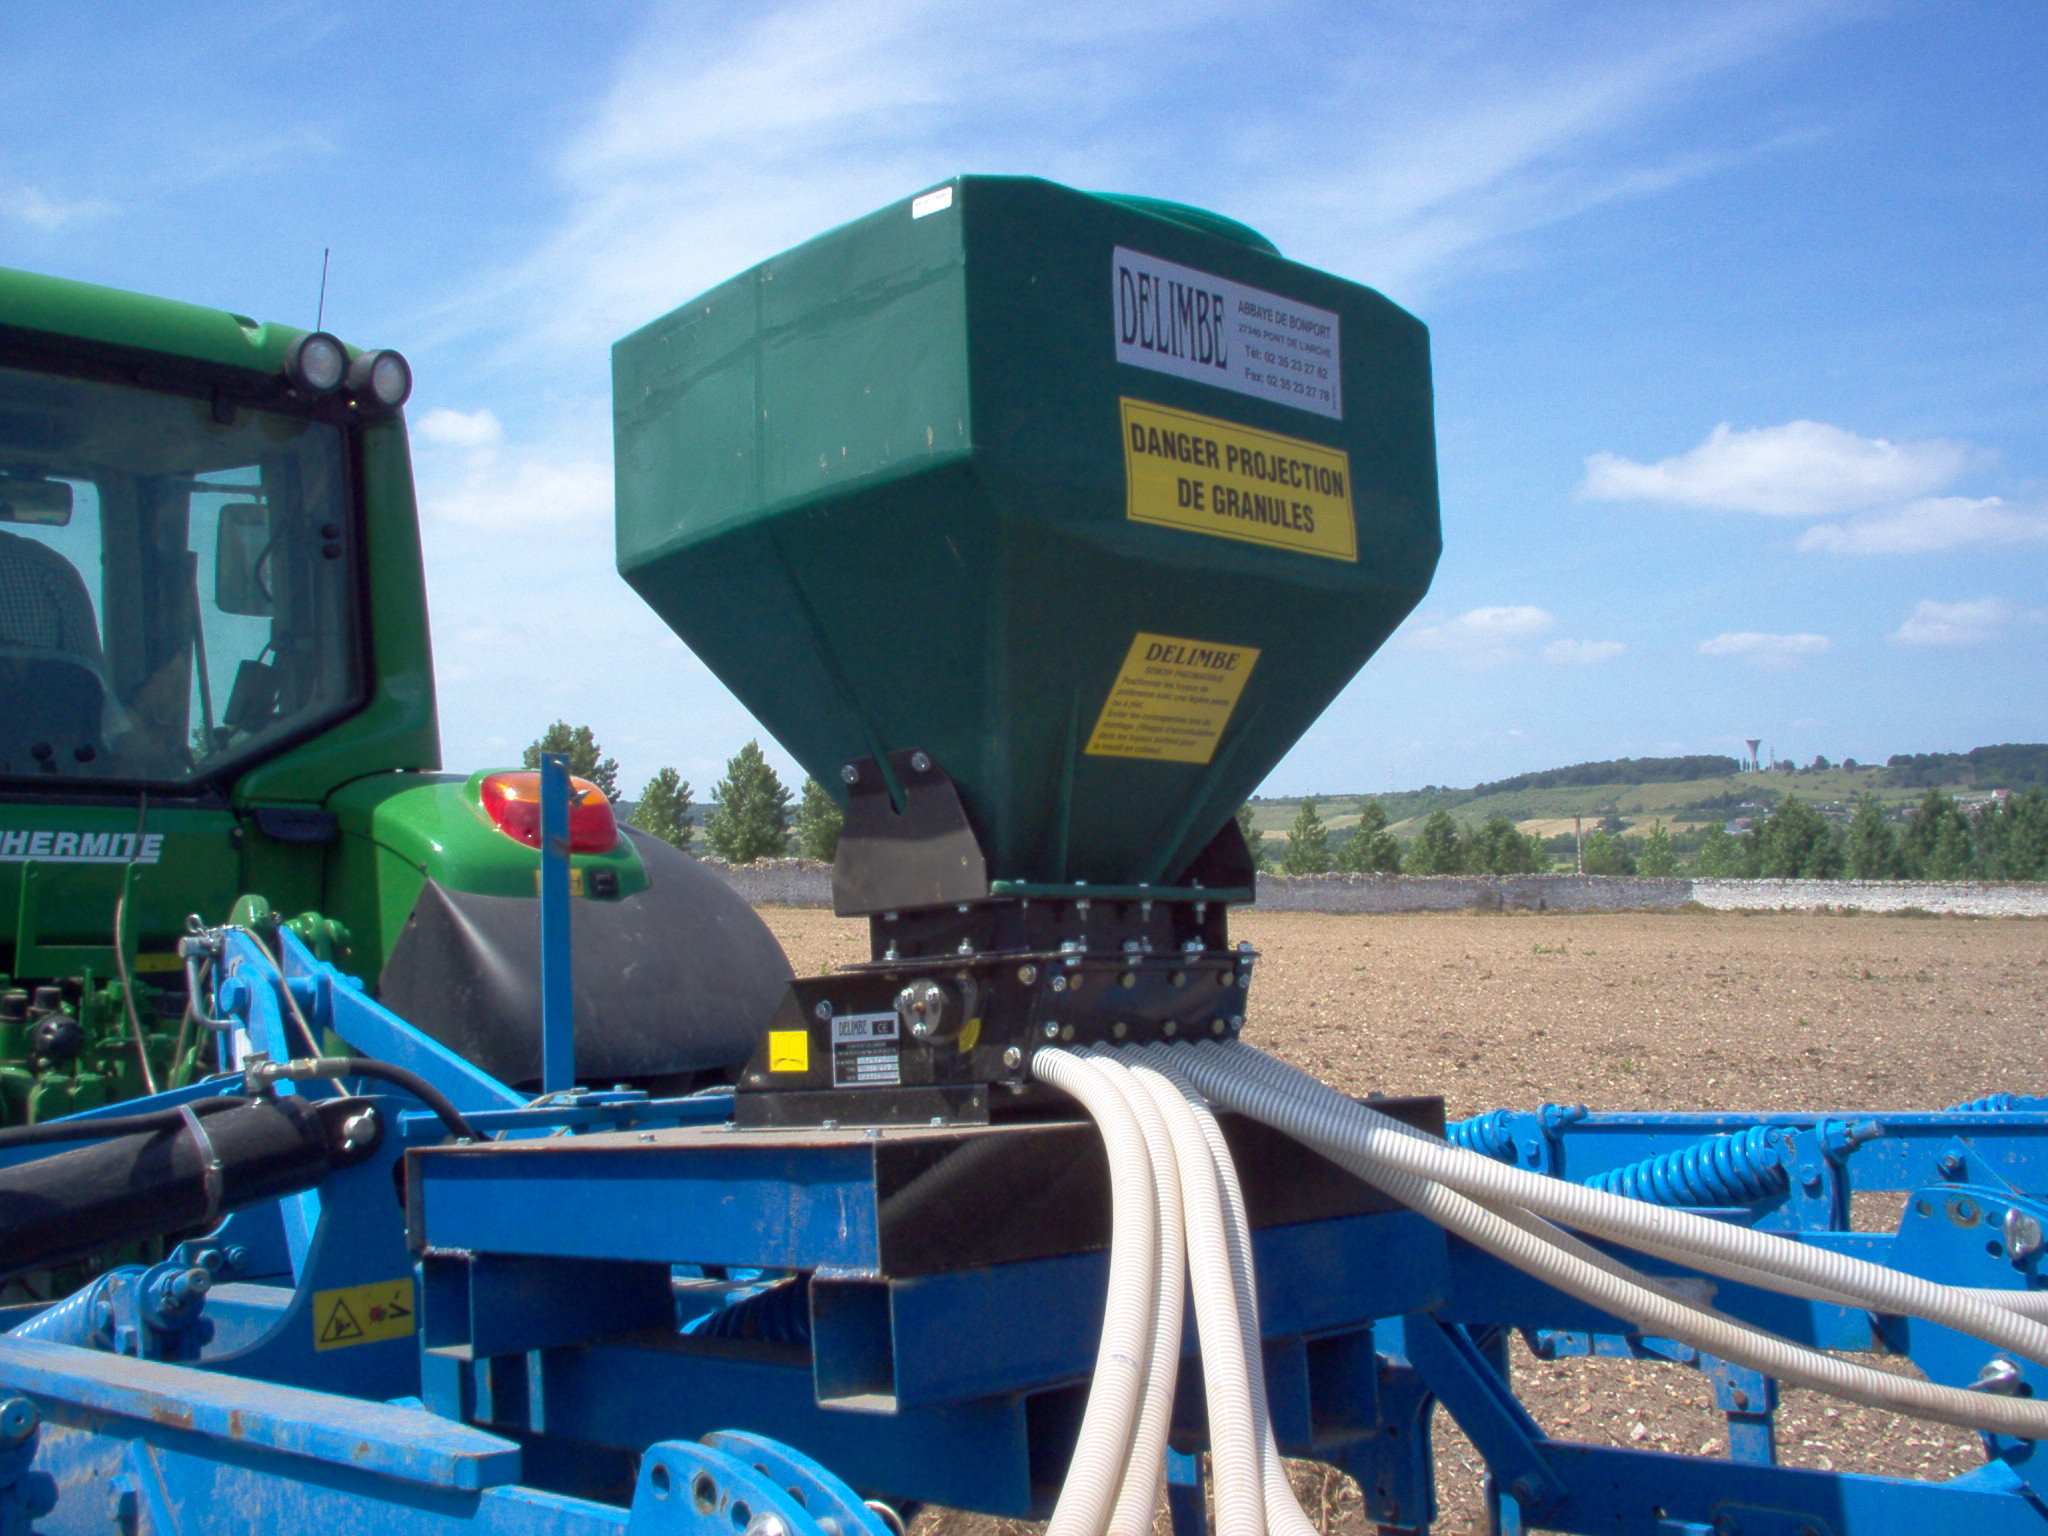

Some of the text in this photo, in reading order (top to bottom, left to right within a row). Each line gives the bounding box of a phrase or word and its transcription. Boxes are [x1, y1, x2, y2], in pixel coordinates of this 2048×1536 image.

[1119, 266, 1228, 370] DELIMBE
[1238, 300, 1331, 339] ABBAYE DE BONPORT
[1263, 330, 1285, 344] PONT
[1287, 337, 1298, 348] DE
[1264, 351, 1276, 364] 02
[1278, 355, 1289, 368] 35
[1291, 359, 1302, 372] 23
[1304, 363, 1315, 375] 27
[1244, 367, 1264, 383] Fax:
[1266, 374, 1278, 387] 02
[1280, 378, 1291, 391] 35
[1293, 382, 1304, 394] 23
[1306, 385, 1317, 398] 27
[1130, 422, 1344, 498] DANGER PROJECTION
[1177, 477, 1315, 533] DE GRANULES
[1145, 642, 1240, 671] DELIMBE
[0, 831, 164, 857] HERMITE
